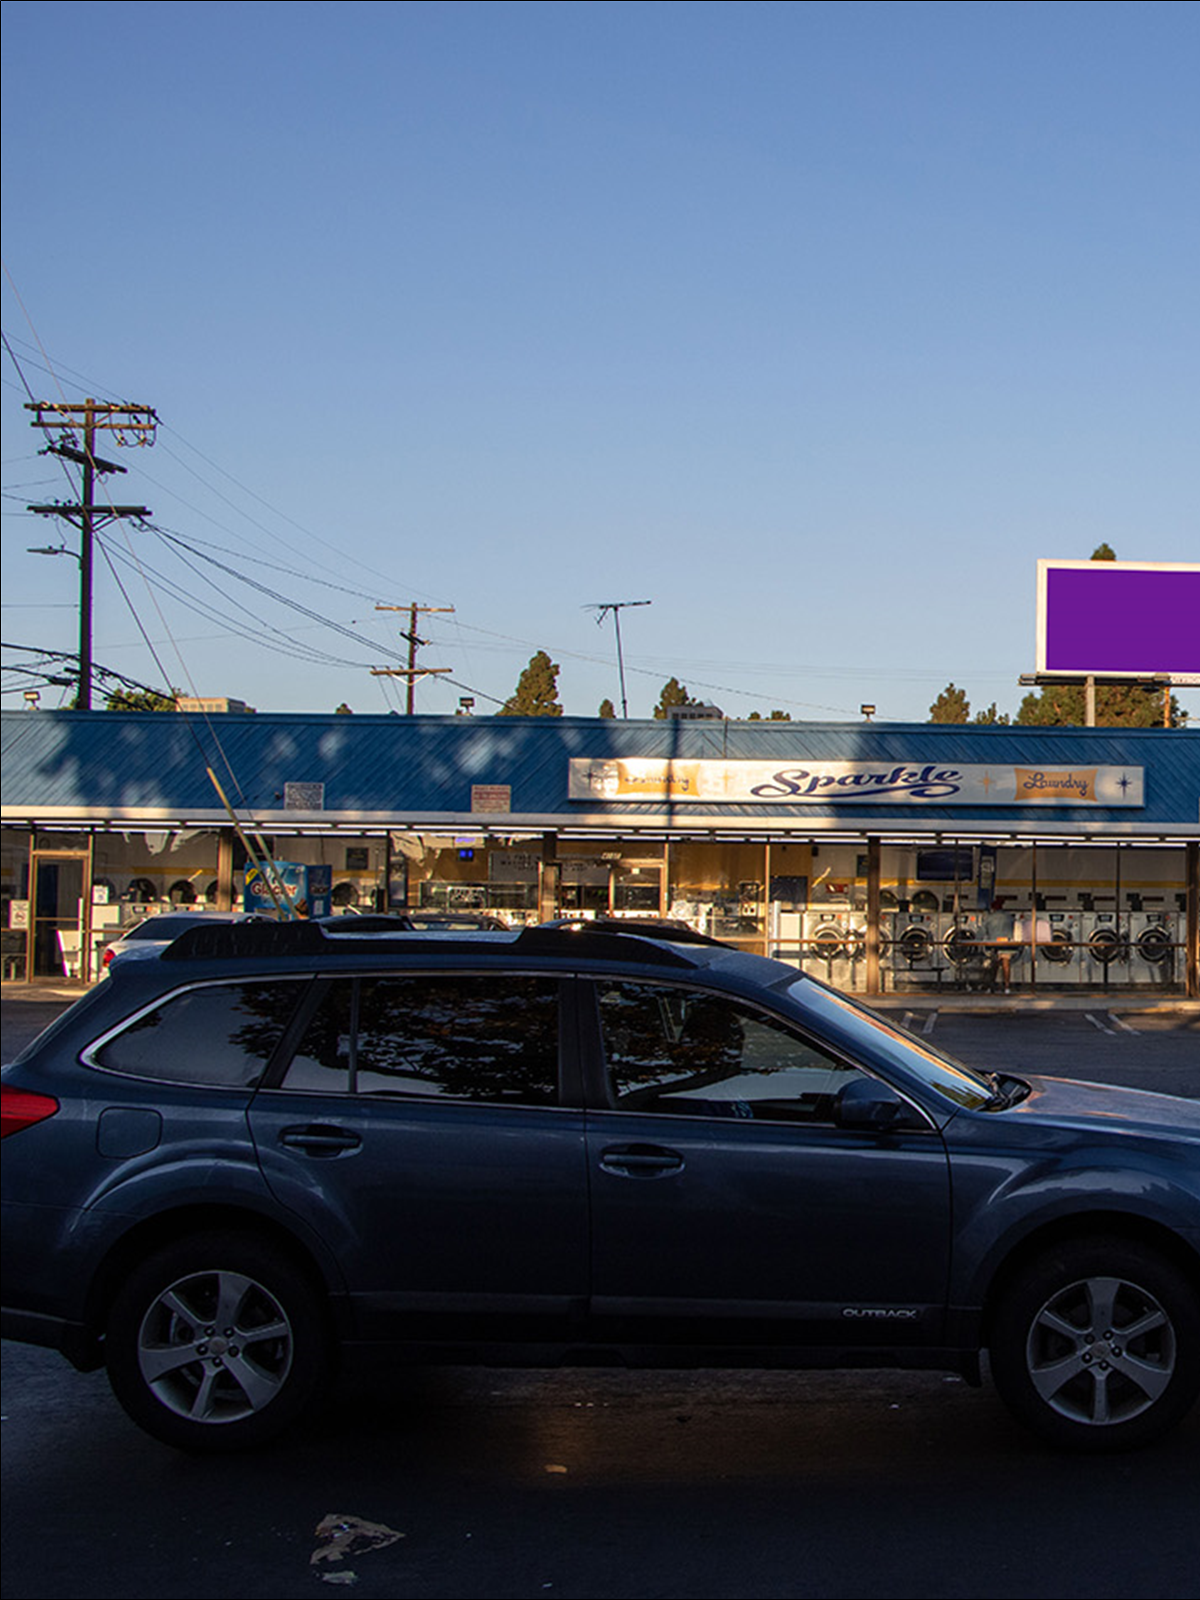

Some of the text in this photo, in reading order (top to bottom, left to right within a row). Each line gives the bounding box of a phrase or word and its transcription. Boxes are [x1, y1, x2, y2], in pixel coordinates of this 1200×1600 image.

[750, 766, 963, 798] Sparkle
[1023, 772, 1089, 796] Laundry
[842, 1308, 917, 1319] OUTBACK
